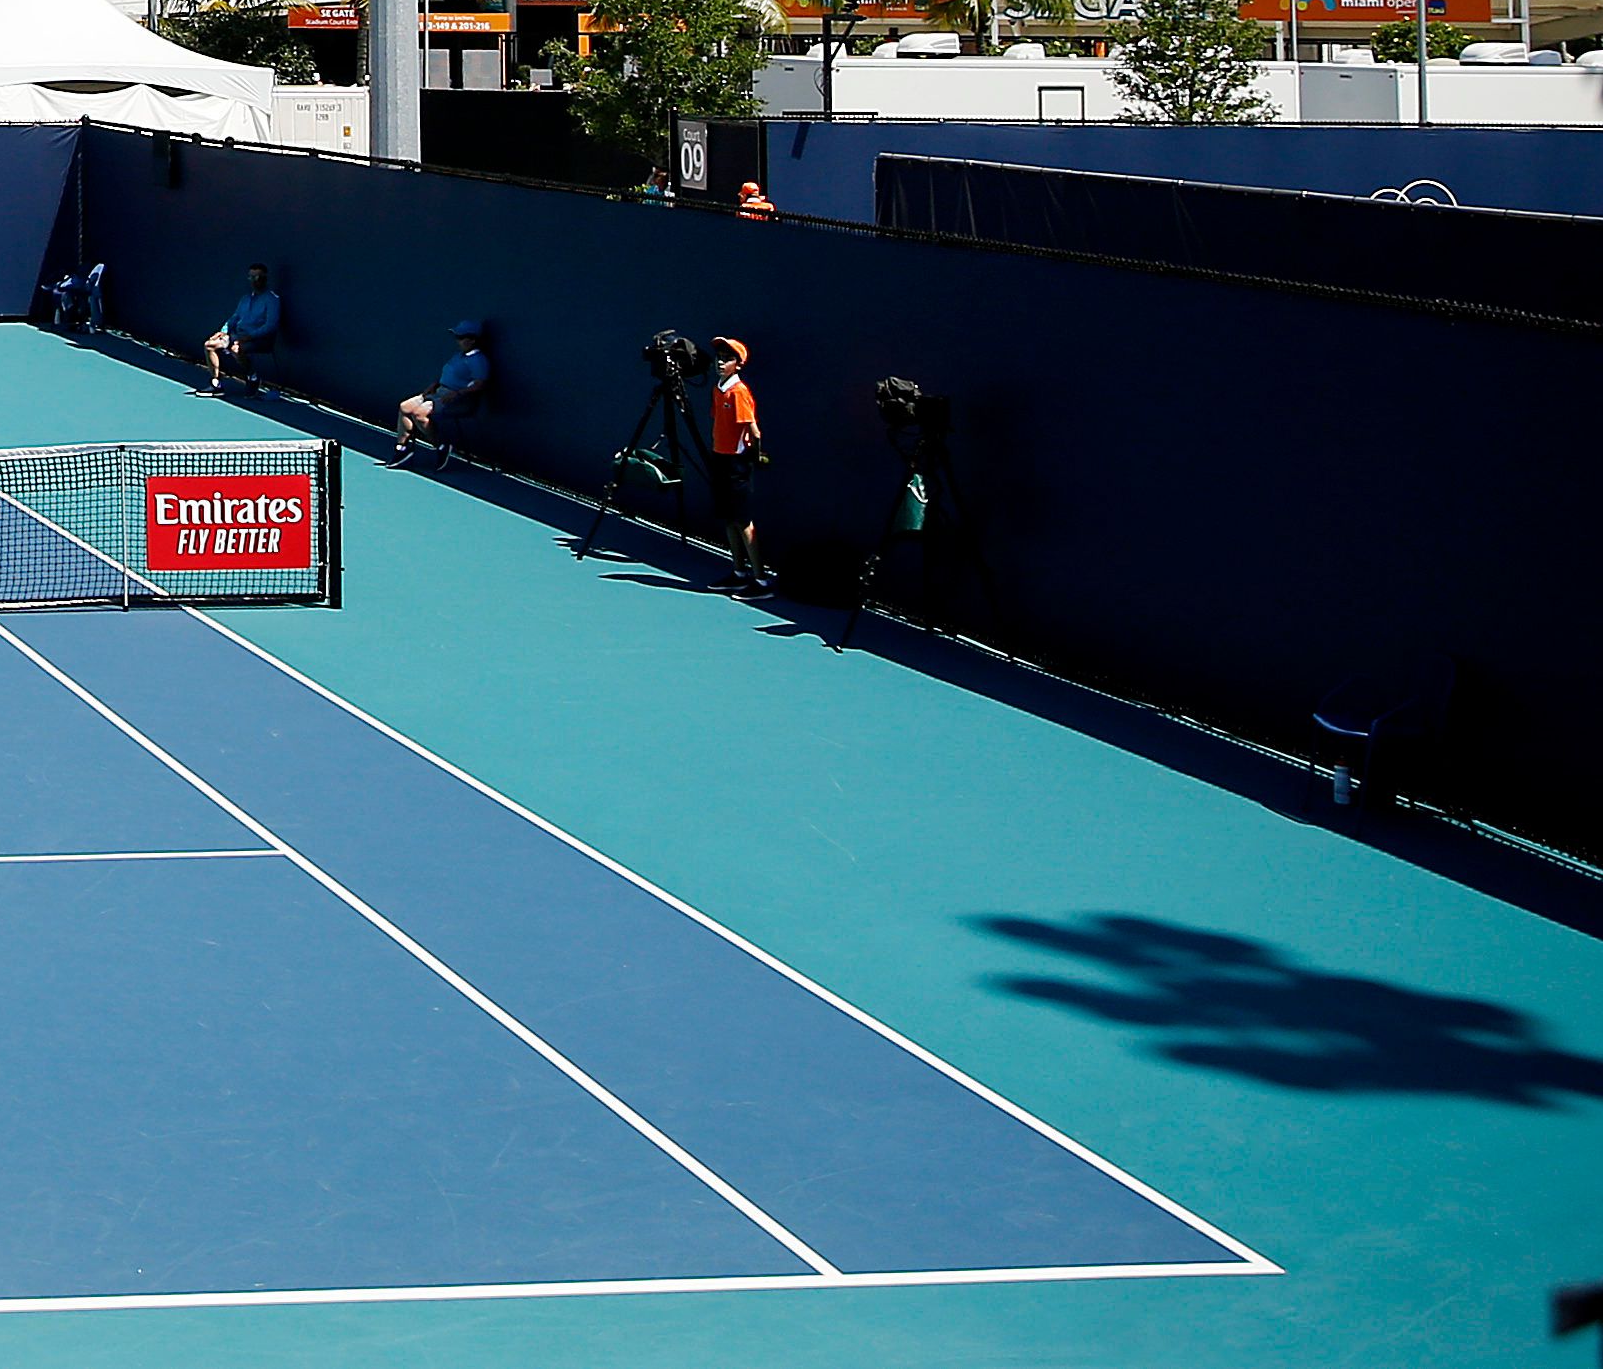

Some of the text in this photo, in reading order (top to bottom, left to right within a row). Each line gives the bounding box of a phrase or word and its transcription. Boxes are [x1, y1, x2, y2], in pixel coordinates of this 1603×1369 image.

[332, 9, 355, 18] GATE
[458, 21, 491, 30] 201-216
[683, 128, 701, 142] Court
[680, 142, 704, 182] 09
[154, 491, 303, 525] Emirates
[177, 528, 281, 555] FLY BETTER
